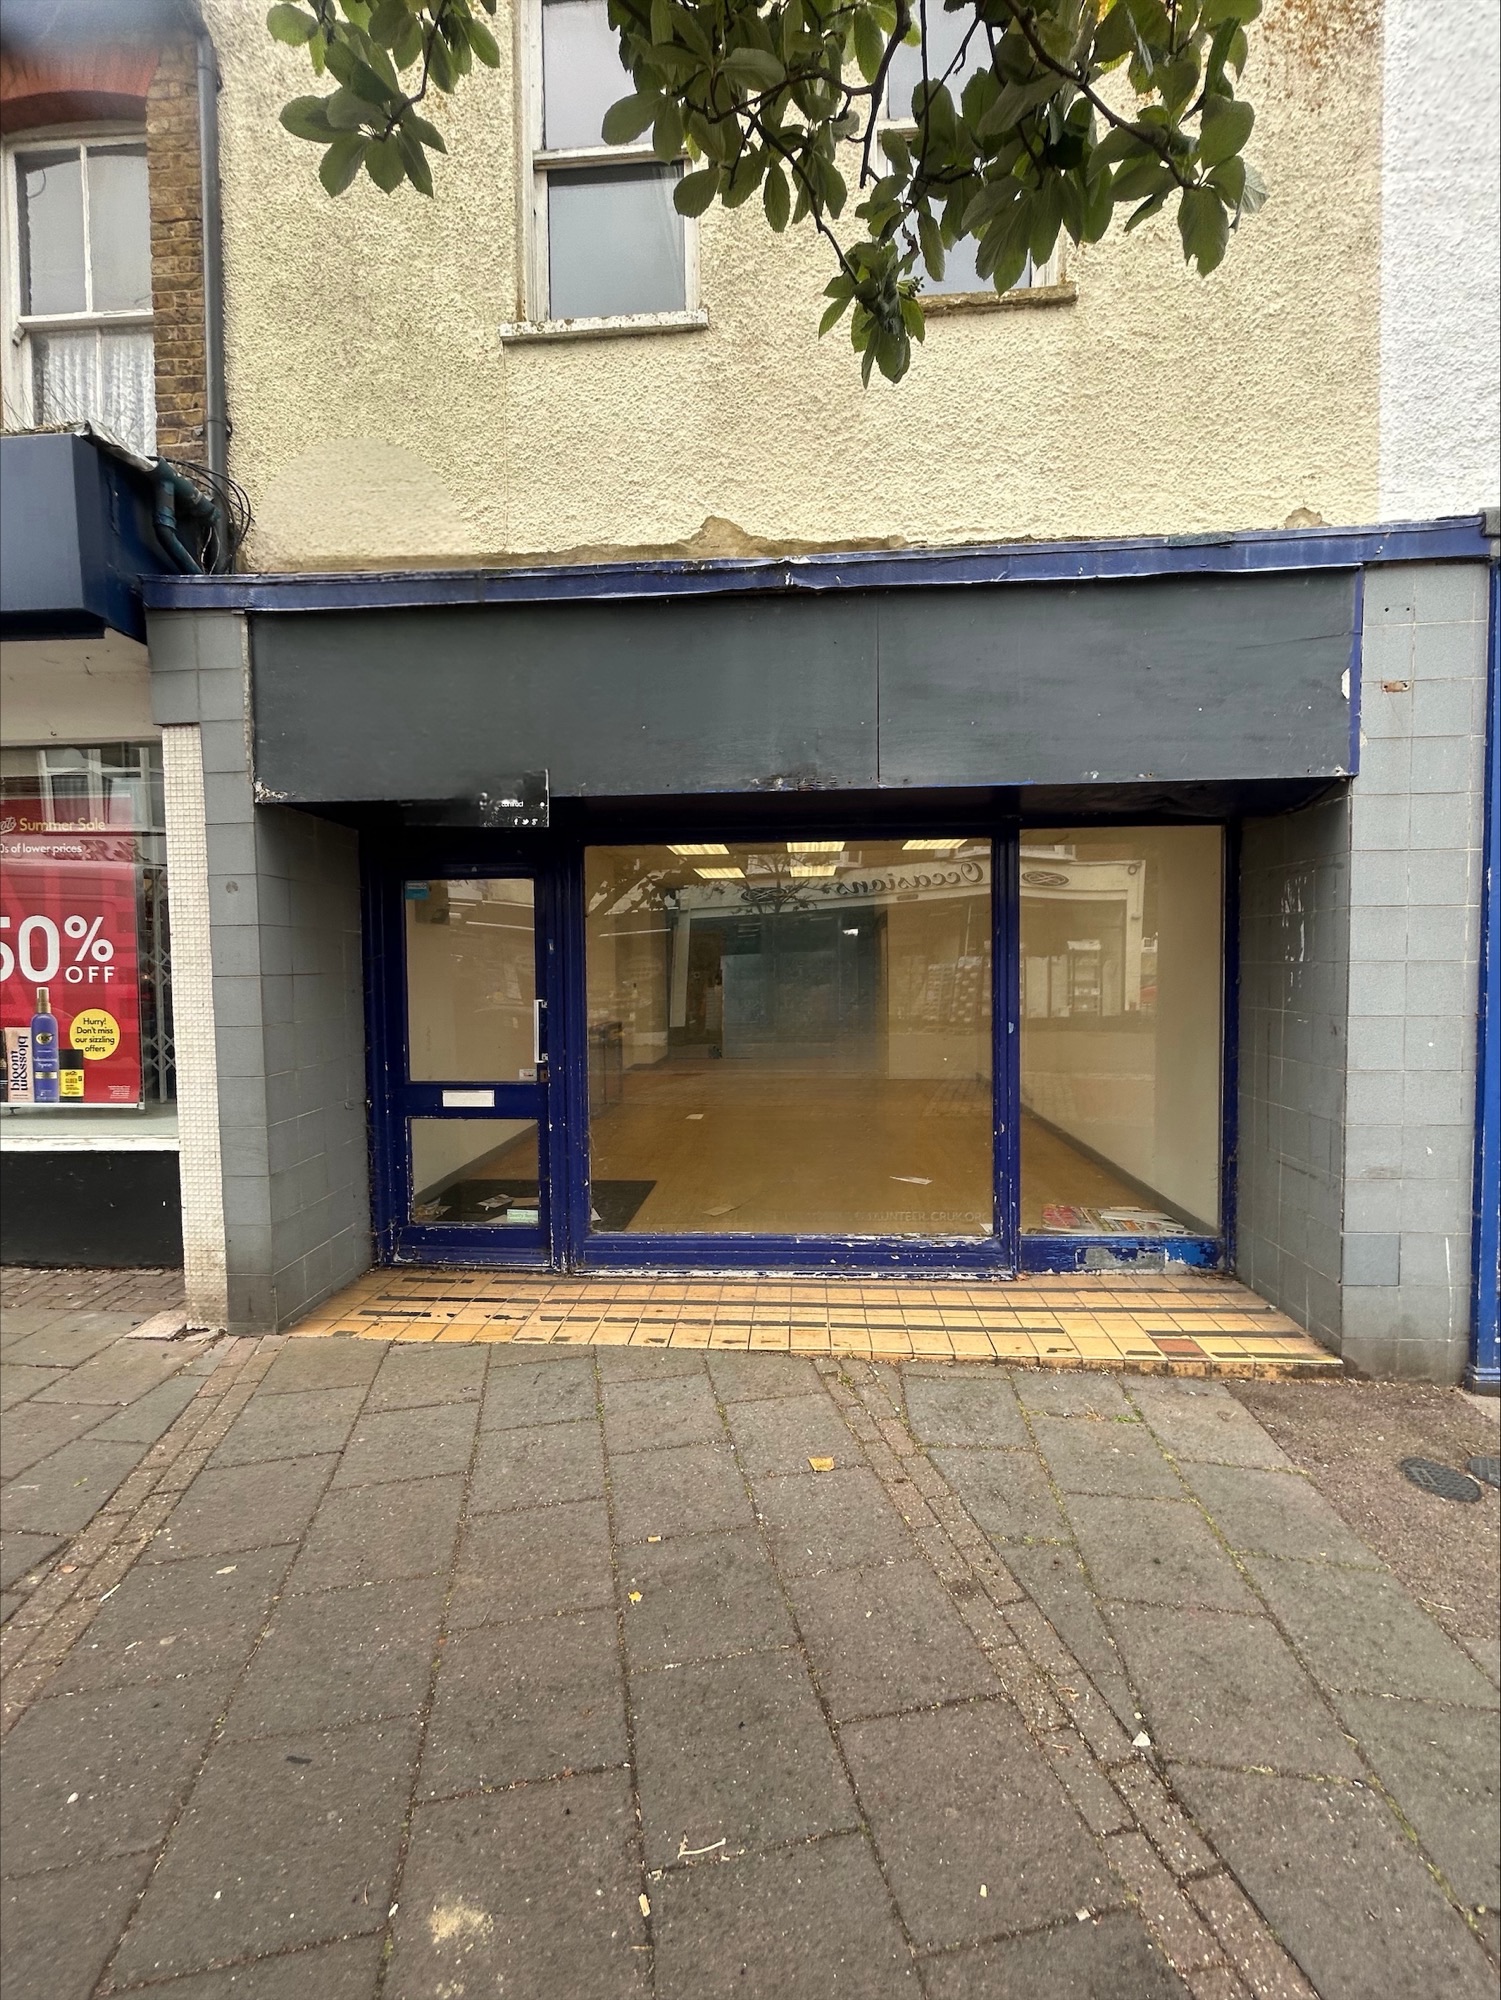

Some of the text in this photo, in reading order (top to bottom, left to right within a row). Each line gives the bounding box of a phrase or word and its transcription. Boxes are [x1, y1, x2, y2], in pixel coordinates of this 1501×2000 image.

[19, 817, 74, 831] Summer
[77, 817, 107, 831] Sale
[11, 842, 22, 853] of
[23, 842, 51, 853] lower
[52, 843, 83, 856] prices
[65, 966, 115, 983] OFF
[83, 1017, 107, 1027] Hurry!
[76, 1026, 114, 1034] Don't miss
[89, 1036, 115, 1046] sizzling
[84, 1044, 106, 1052] offers
